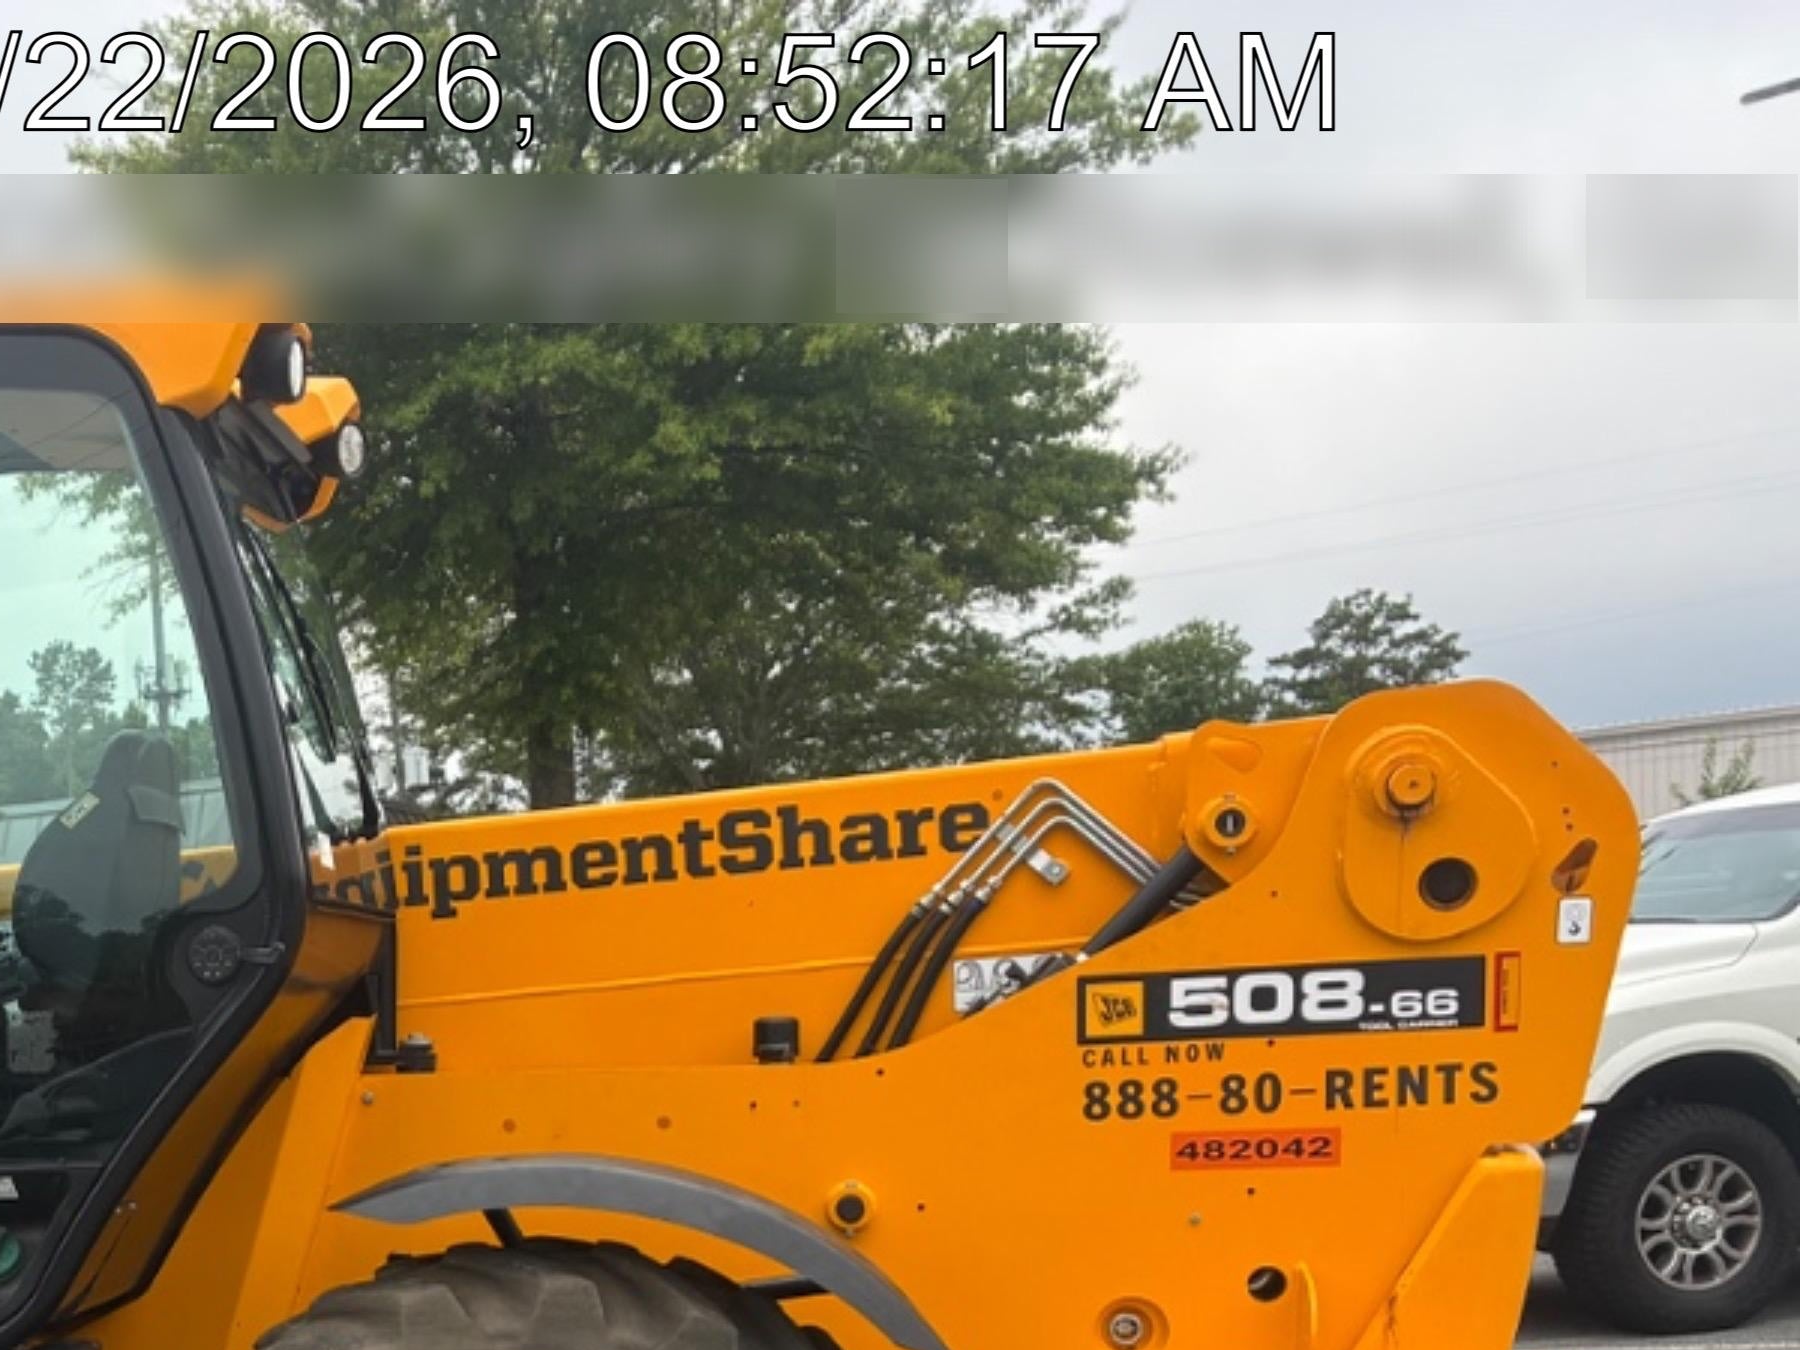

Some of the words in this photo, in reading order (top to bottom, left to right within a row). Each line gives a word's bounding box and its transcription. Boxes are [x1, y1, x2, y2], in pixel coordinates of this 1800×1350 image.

[1167, 969, 1459, 1028] 508-66
[1082, 1047, 1150, 1067] CALL
[1164, 1043, 1225, 1064] NOW
[1082, 1062, 1500, 1121] 888-80-RENTS
[1175, 1136, 1333, 1163] 482042
